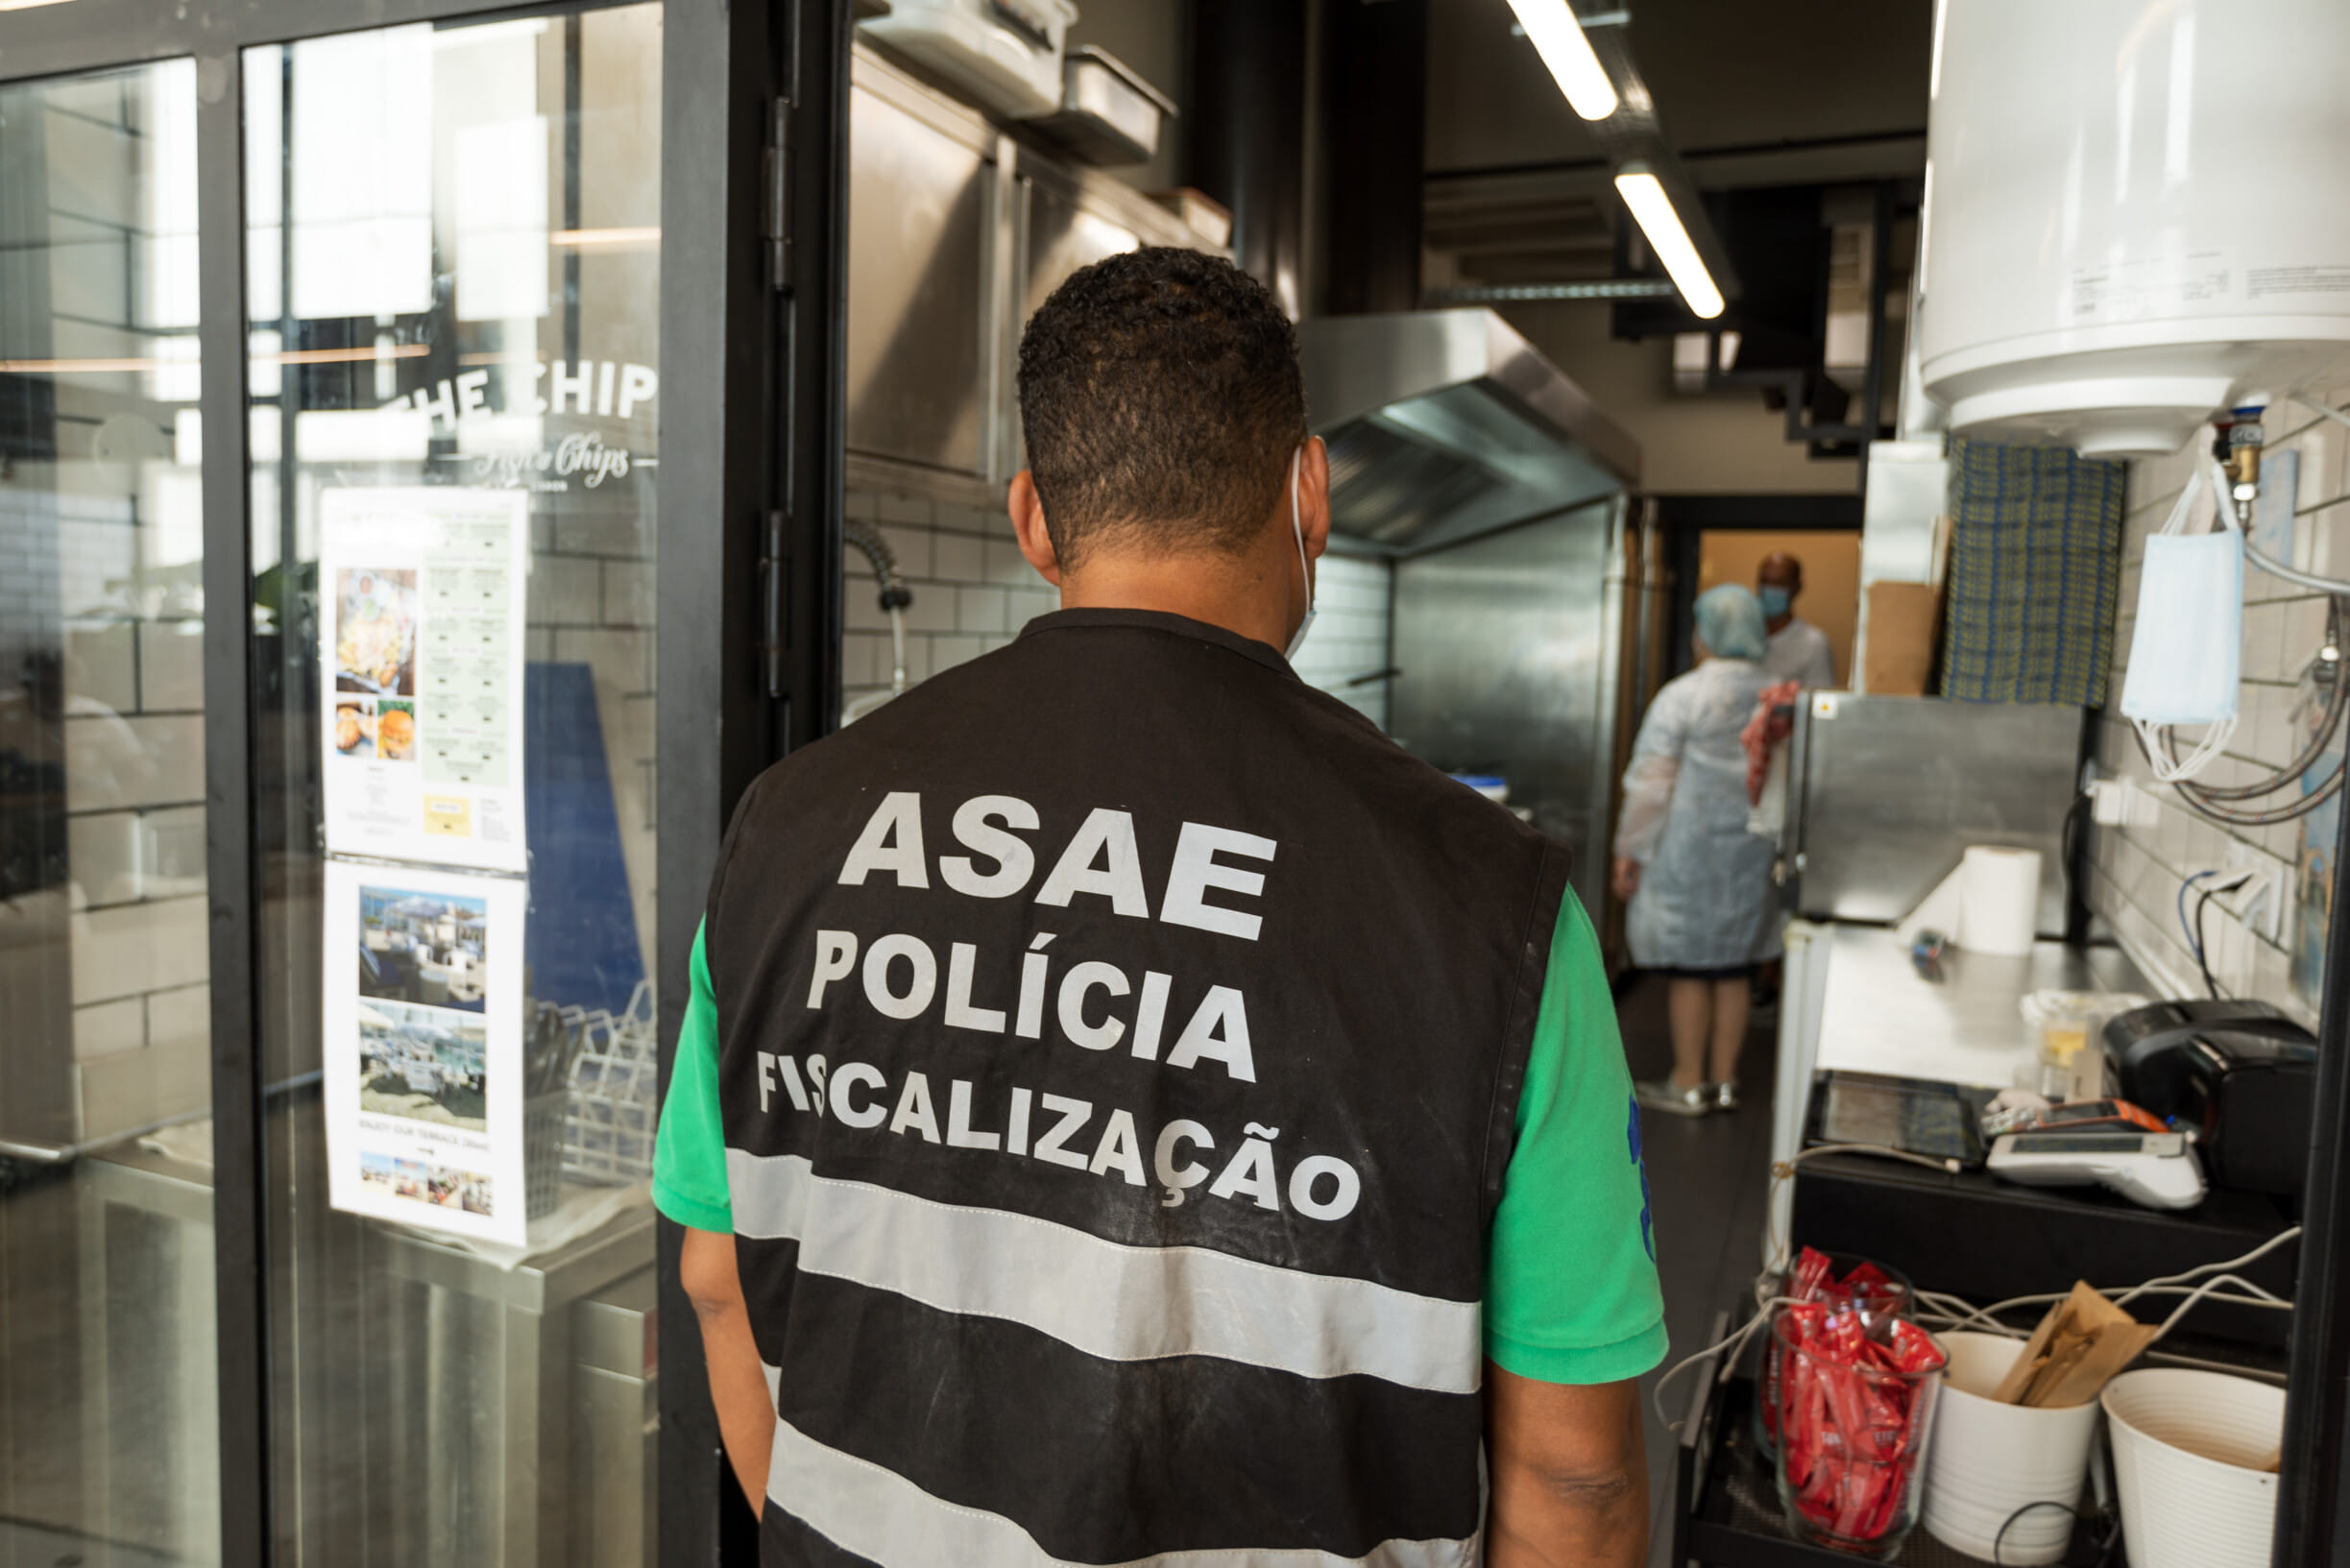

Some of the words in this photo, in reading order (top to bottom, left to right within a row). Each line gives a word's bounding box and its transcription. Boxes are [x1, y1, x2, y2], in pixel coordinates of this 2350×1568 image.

[555, 431, 629, 489] Chips
[837, 792, 1277, 941] ASAE
[806, 930, 1257, 1083] POLÍCIA
[757, 1050, 1361, 1221] FISCALIZAÇÃO
